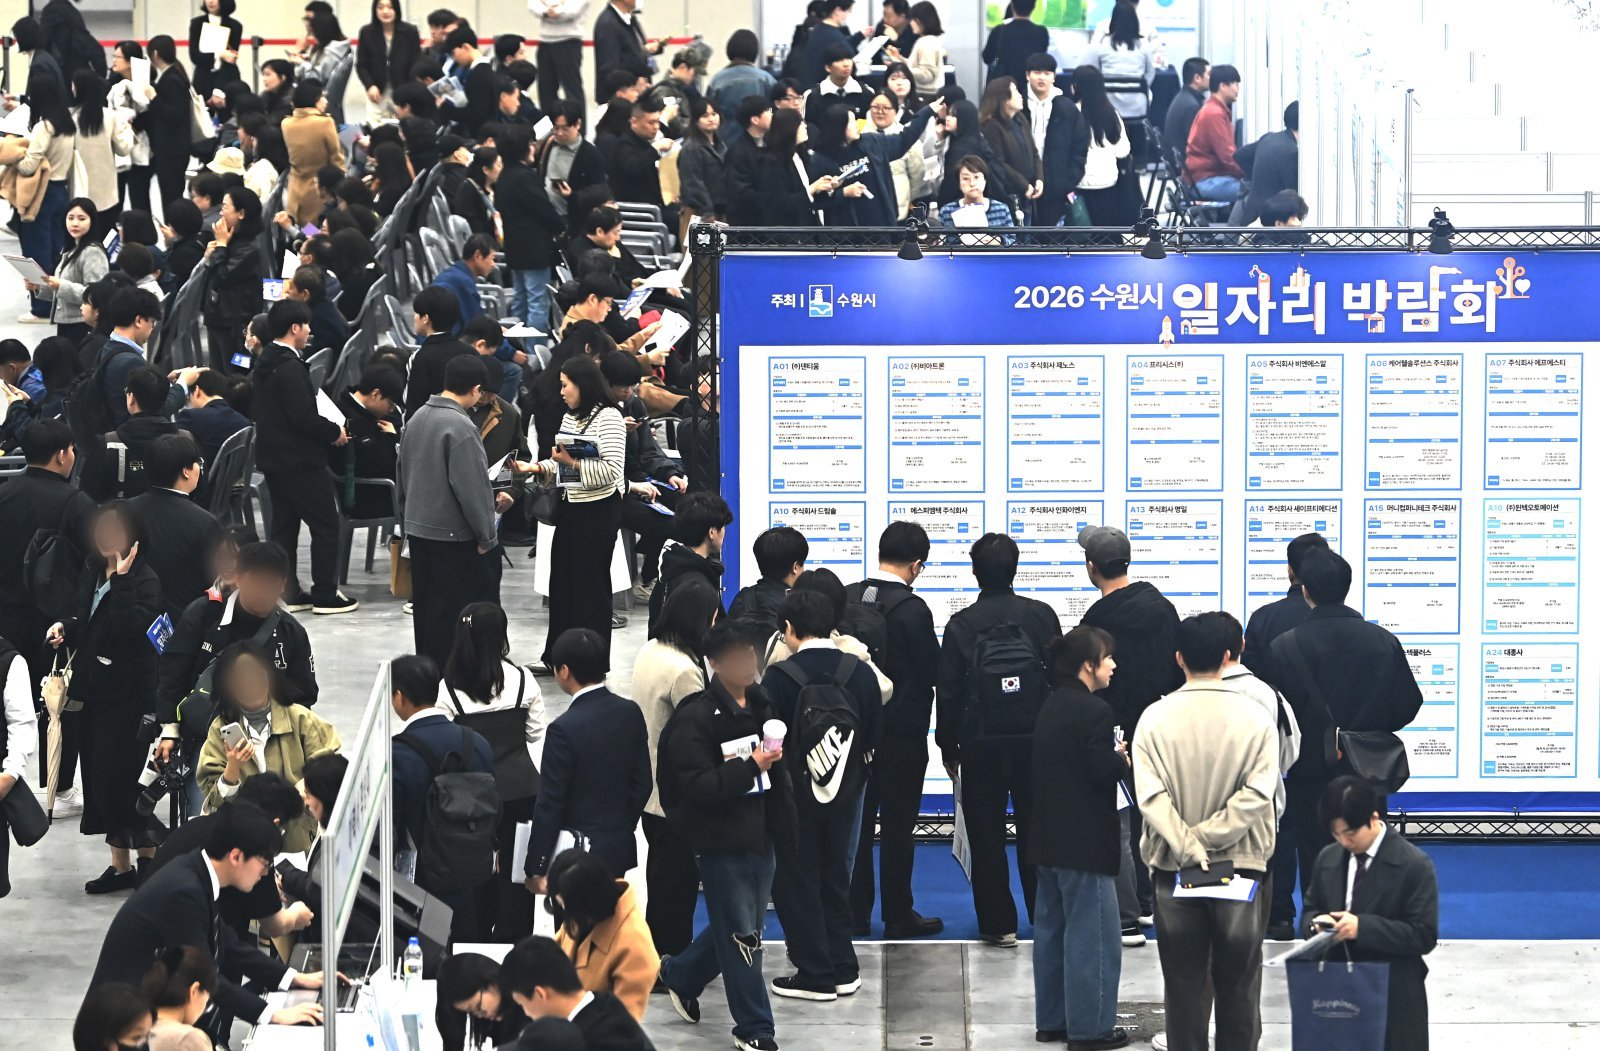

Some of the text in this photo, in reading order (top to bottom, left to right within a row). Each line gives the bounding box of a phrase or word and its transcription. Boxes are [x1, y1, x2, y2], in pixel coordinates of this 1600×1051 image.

[771, 293, 796, 308] 주최
[837, 292, 876, 308] 수원시
[1014, 276, 1496, 336] 2026 수원시 일자리 박람회
[773, 361, 789, 371] A01
[892, 361, 945, 371] A02 (주)비아트론
[1011, 360, 1029, 370] A03
[1030, 360, 1055, 370] 주식회사
[1131, 359, 1149, 369] A04
[1250, 359, 1268, 369] A05
[1269, 358, 1295, 369] 주식회사
[1370, 359, 1388, 369] A06
[1434, 358, 1459, 369] 주식회사
[1489, 358, 1566, 368] A07 주식회사 에프에스티
[773, 505, 790, 514] A10
[791, 504, 817, 515] 주식회사
[892, 504, 906, 514] A11
[943, 504, 968, 514] 주식회사
[1011, 504, 1027, 514] A12
[1029, 504, 1055, 515] 주식회사
[1130, 503, 1146, 513] A13
[1149, 503, 1174, 513] 주식회사
[1249, 502, 1265, 512] A14
[1267, 502, 1293, 513] 주식회사
[1368, 502, 1384, 512] A15
[1431, 502, 1458, 512] 주식회사
[1488, 502, 1503, 512] A16
[1486, 649, 1503, 657] A24
[806, 725, 848, 783] NIKE
